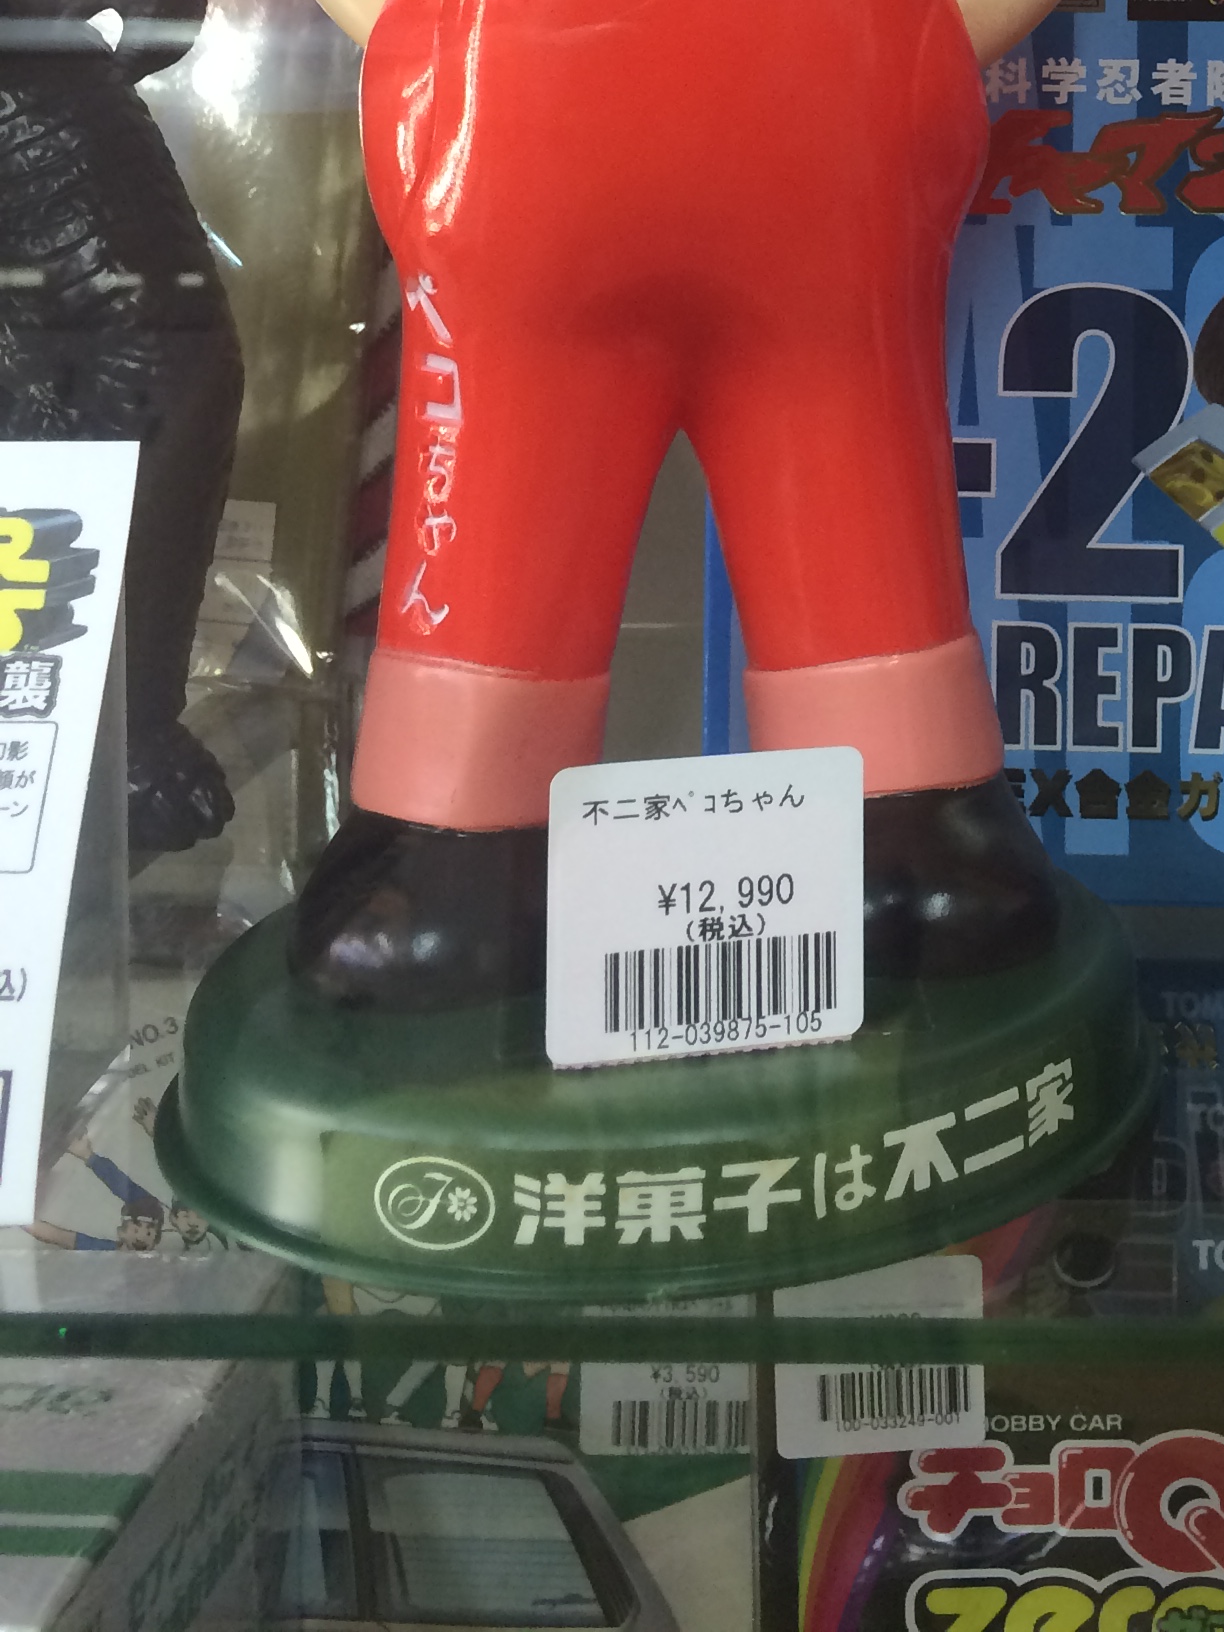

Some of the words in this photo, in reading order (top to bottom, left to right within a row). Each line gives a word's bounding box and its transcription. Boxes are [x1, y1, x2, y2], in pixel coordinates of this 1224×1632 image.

[658, 873, 795, 917] ¥12,990
[687, 914, 766, 942] (税込)
[629, 1011, 823, 1052] 112-039875-105
[513, 1057, 1075, 1246] 洋菓子は不二家
[1069, 1413, 1123, 1432] CAR
